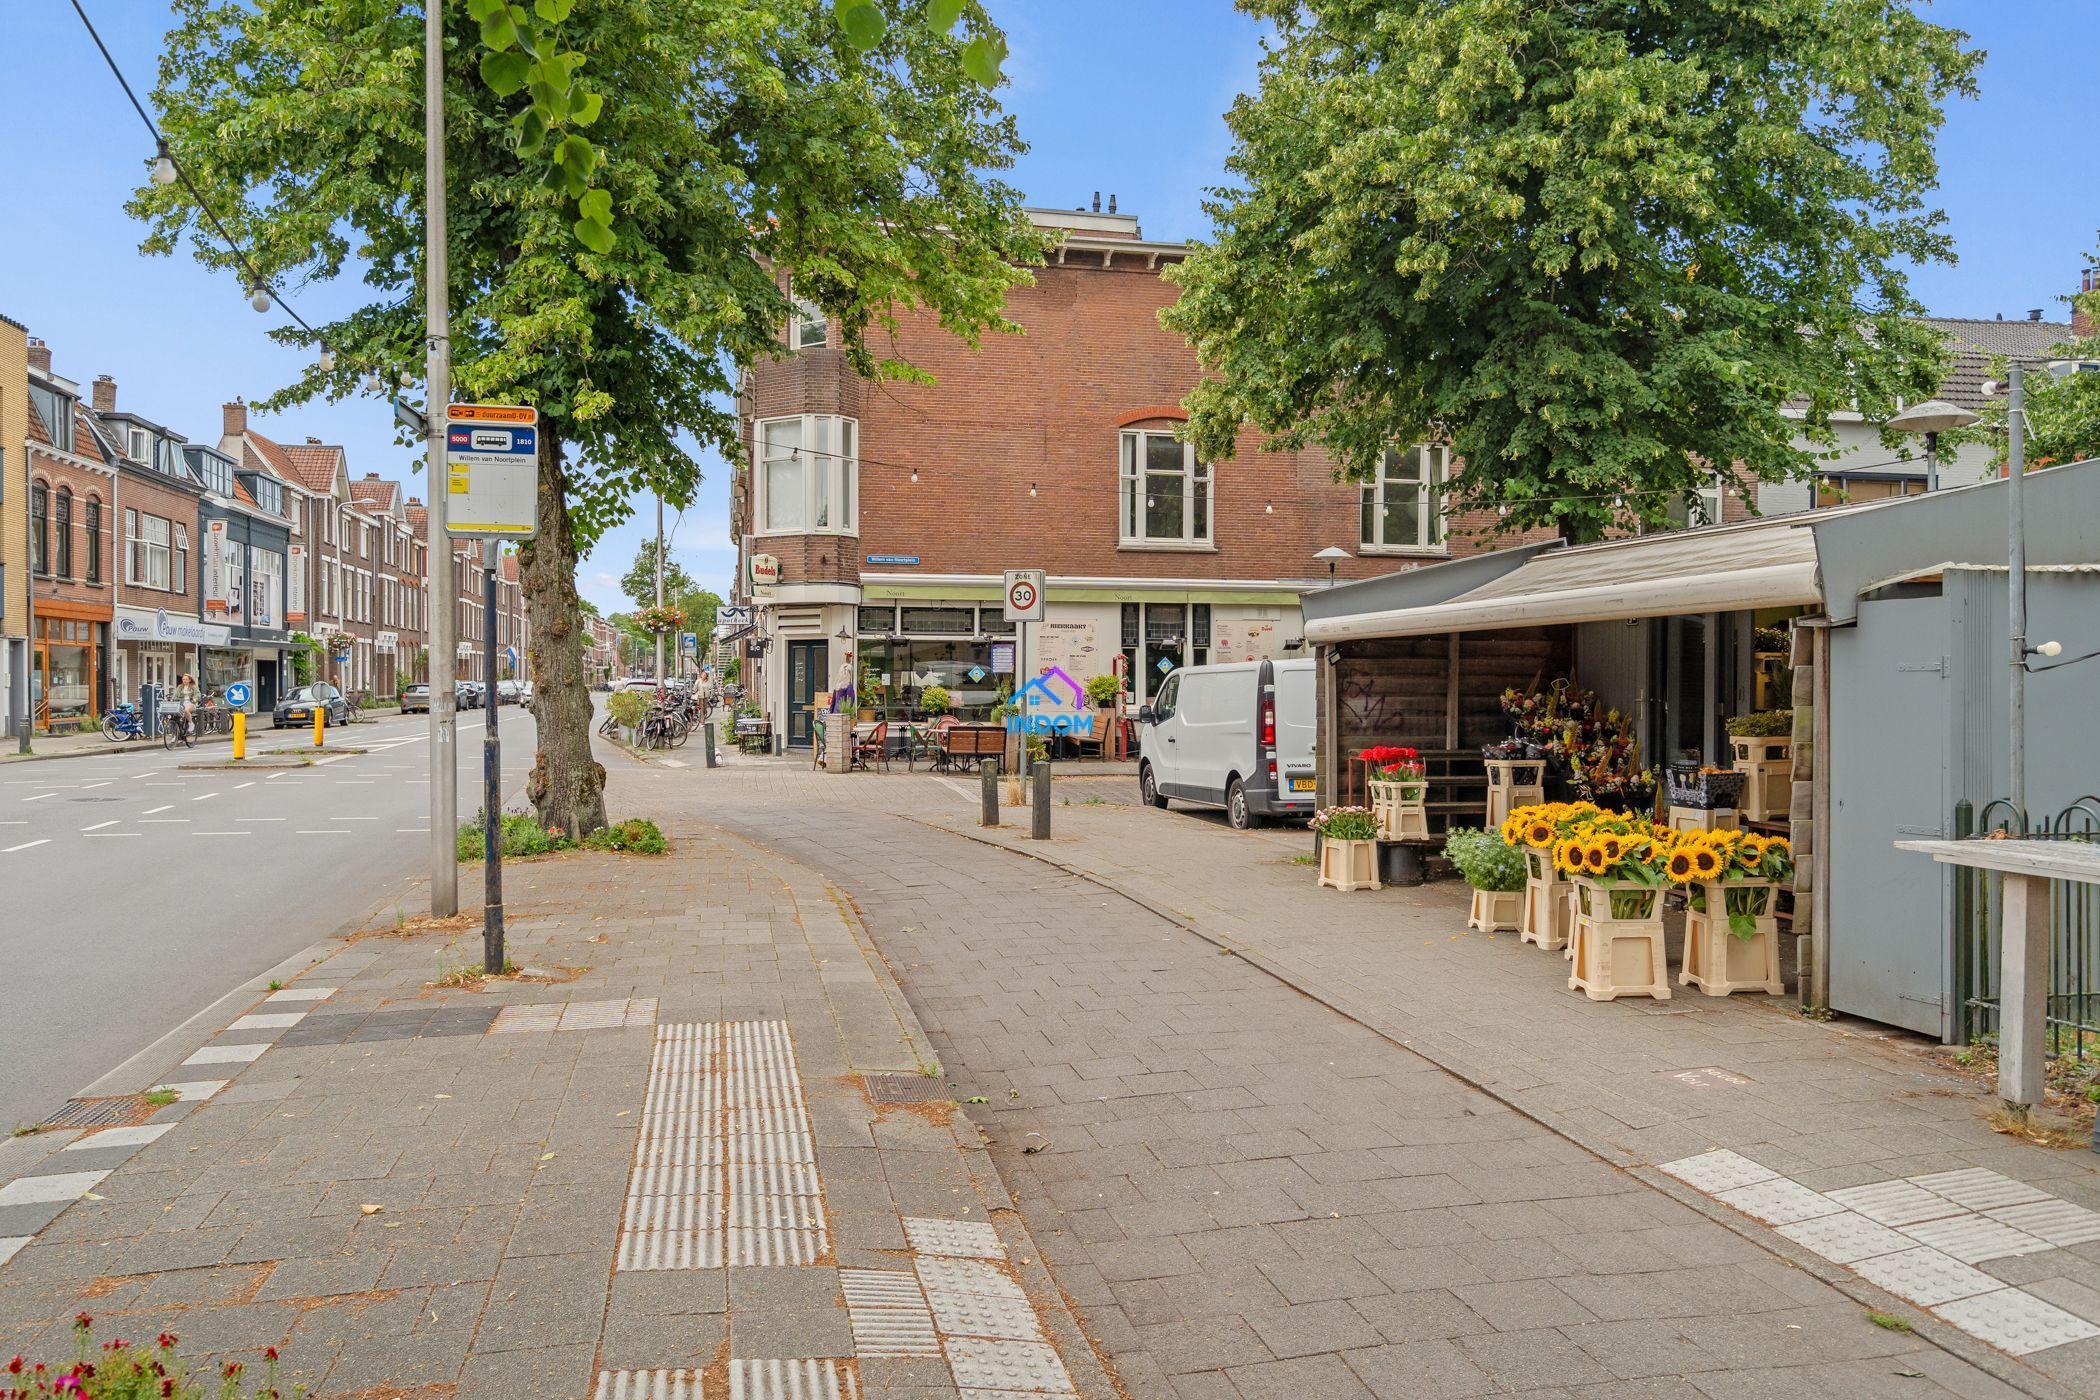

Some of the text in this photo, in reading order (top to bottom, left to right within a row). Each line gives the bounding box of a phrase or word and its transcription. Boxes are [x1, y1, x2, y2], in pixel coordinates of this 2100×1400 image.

[494, 456, 526, 464] Noortplein
[755, 564, 776, 576] Budels
[887, 589, 905, 597] Noort
[1014, 590, 1032, 601] 30
[1113, 591, 1132, 600] Noort
[128, 625, 149, 633] Pauw
[162, 622, 177, 636] Pauw
